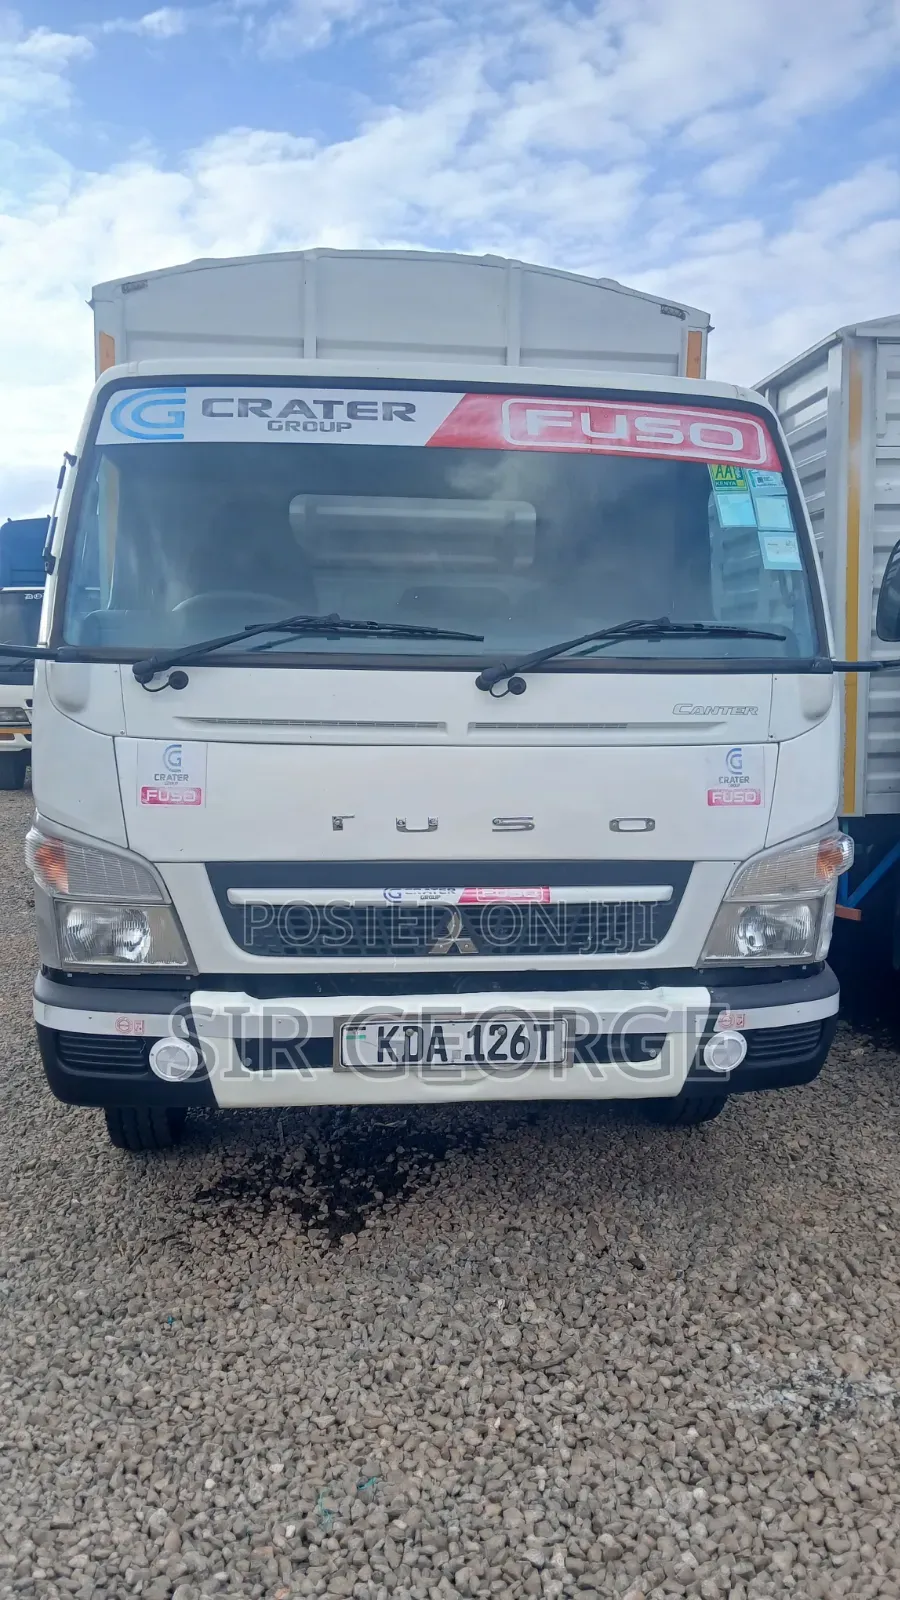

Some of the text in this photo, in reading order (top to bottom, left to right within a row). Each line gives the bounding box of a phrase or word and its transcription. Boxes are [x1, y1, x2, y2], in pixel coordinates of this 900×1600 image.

[201, 397, 417, 422] CRATER
[267, 420, 352, 433] GROUP
[524, 409, 744, 451] FUSO
[672, 703, 759, 716] CANTER
[154, 774, 189, 782] CRATER
[718, 776, 750, 784] CRATER
[146, 789, 197, 802] FUSO
[712, 791, 757, 803] FUSO
[377, 1023, 555, 1063] KDA 126T
